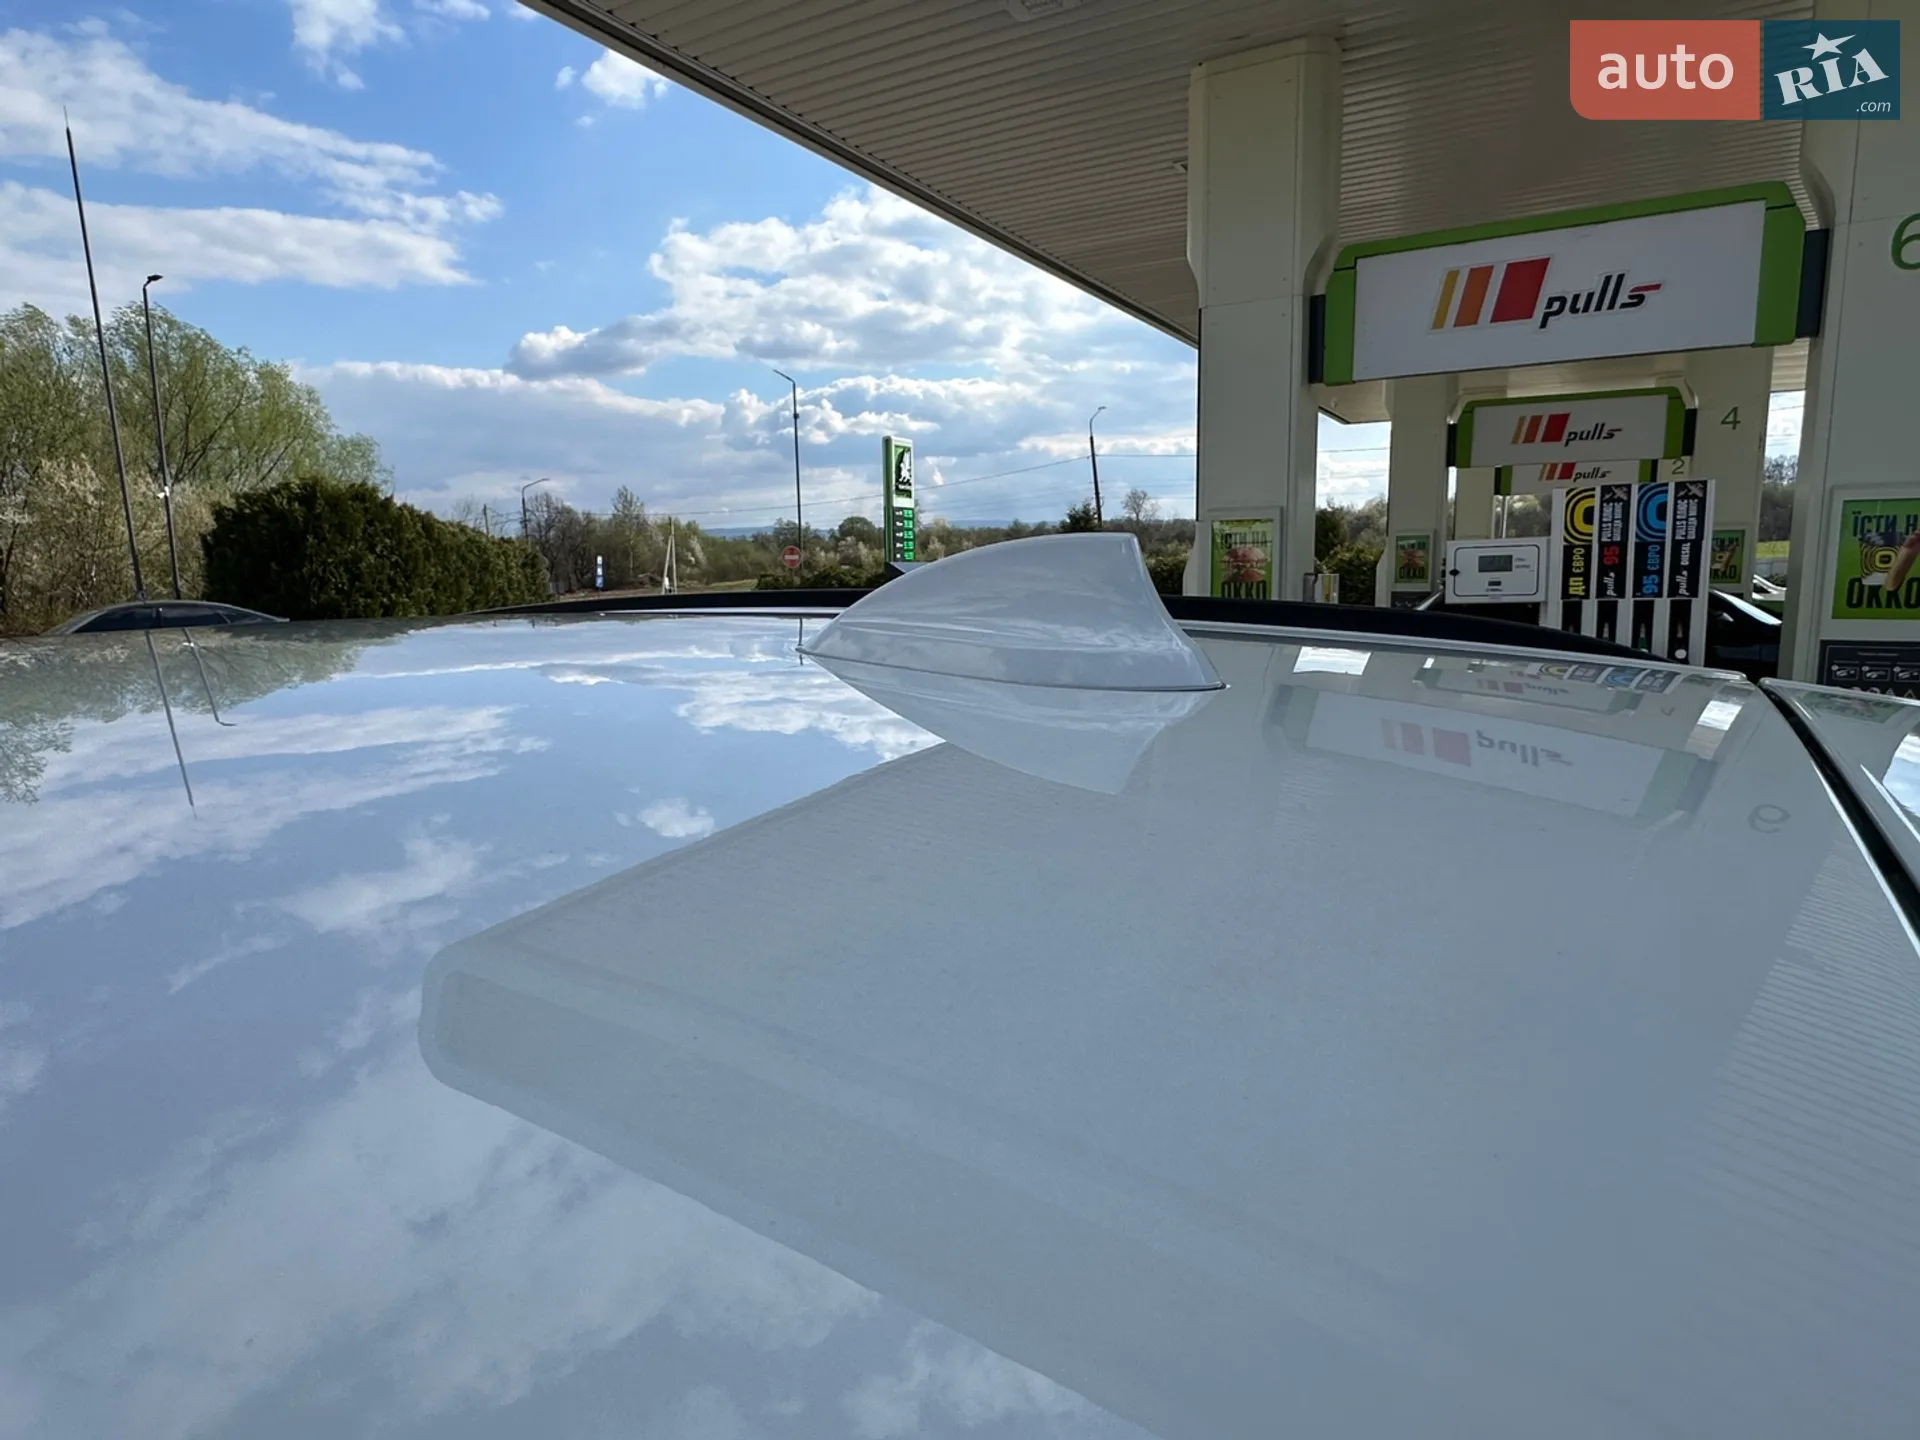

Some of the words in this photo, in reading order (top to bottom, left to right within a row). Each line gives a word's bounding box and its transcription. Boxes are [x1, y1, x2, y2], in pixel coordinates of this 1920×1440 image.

[1891, 212, 1920, 270] 6
[1538, 273, 1662, 329] pulls
[1720, 407, 1741, 430] 4
[1564, 423, 1622, 447] pulls
[1573, 467, 1611, 482] pulls
[1671, 459, 1685, 475] 2
[1852, 510, 1898, 537] ЇСТИ
[1572, 547, 1585, 573] ЄВРО
[1604, 545, 1620, 566] 95
[1647, 544, 1660, 570] ЄВРО
[1568, 577, 1586, 596] ДП
[1642, 574, 1659, 594] 95
